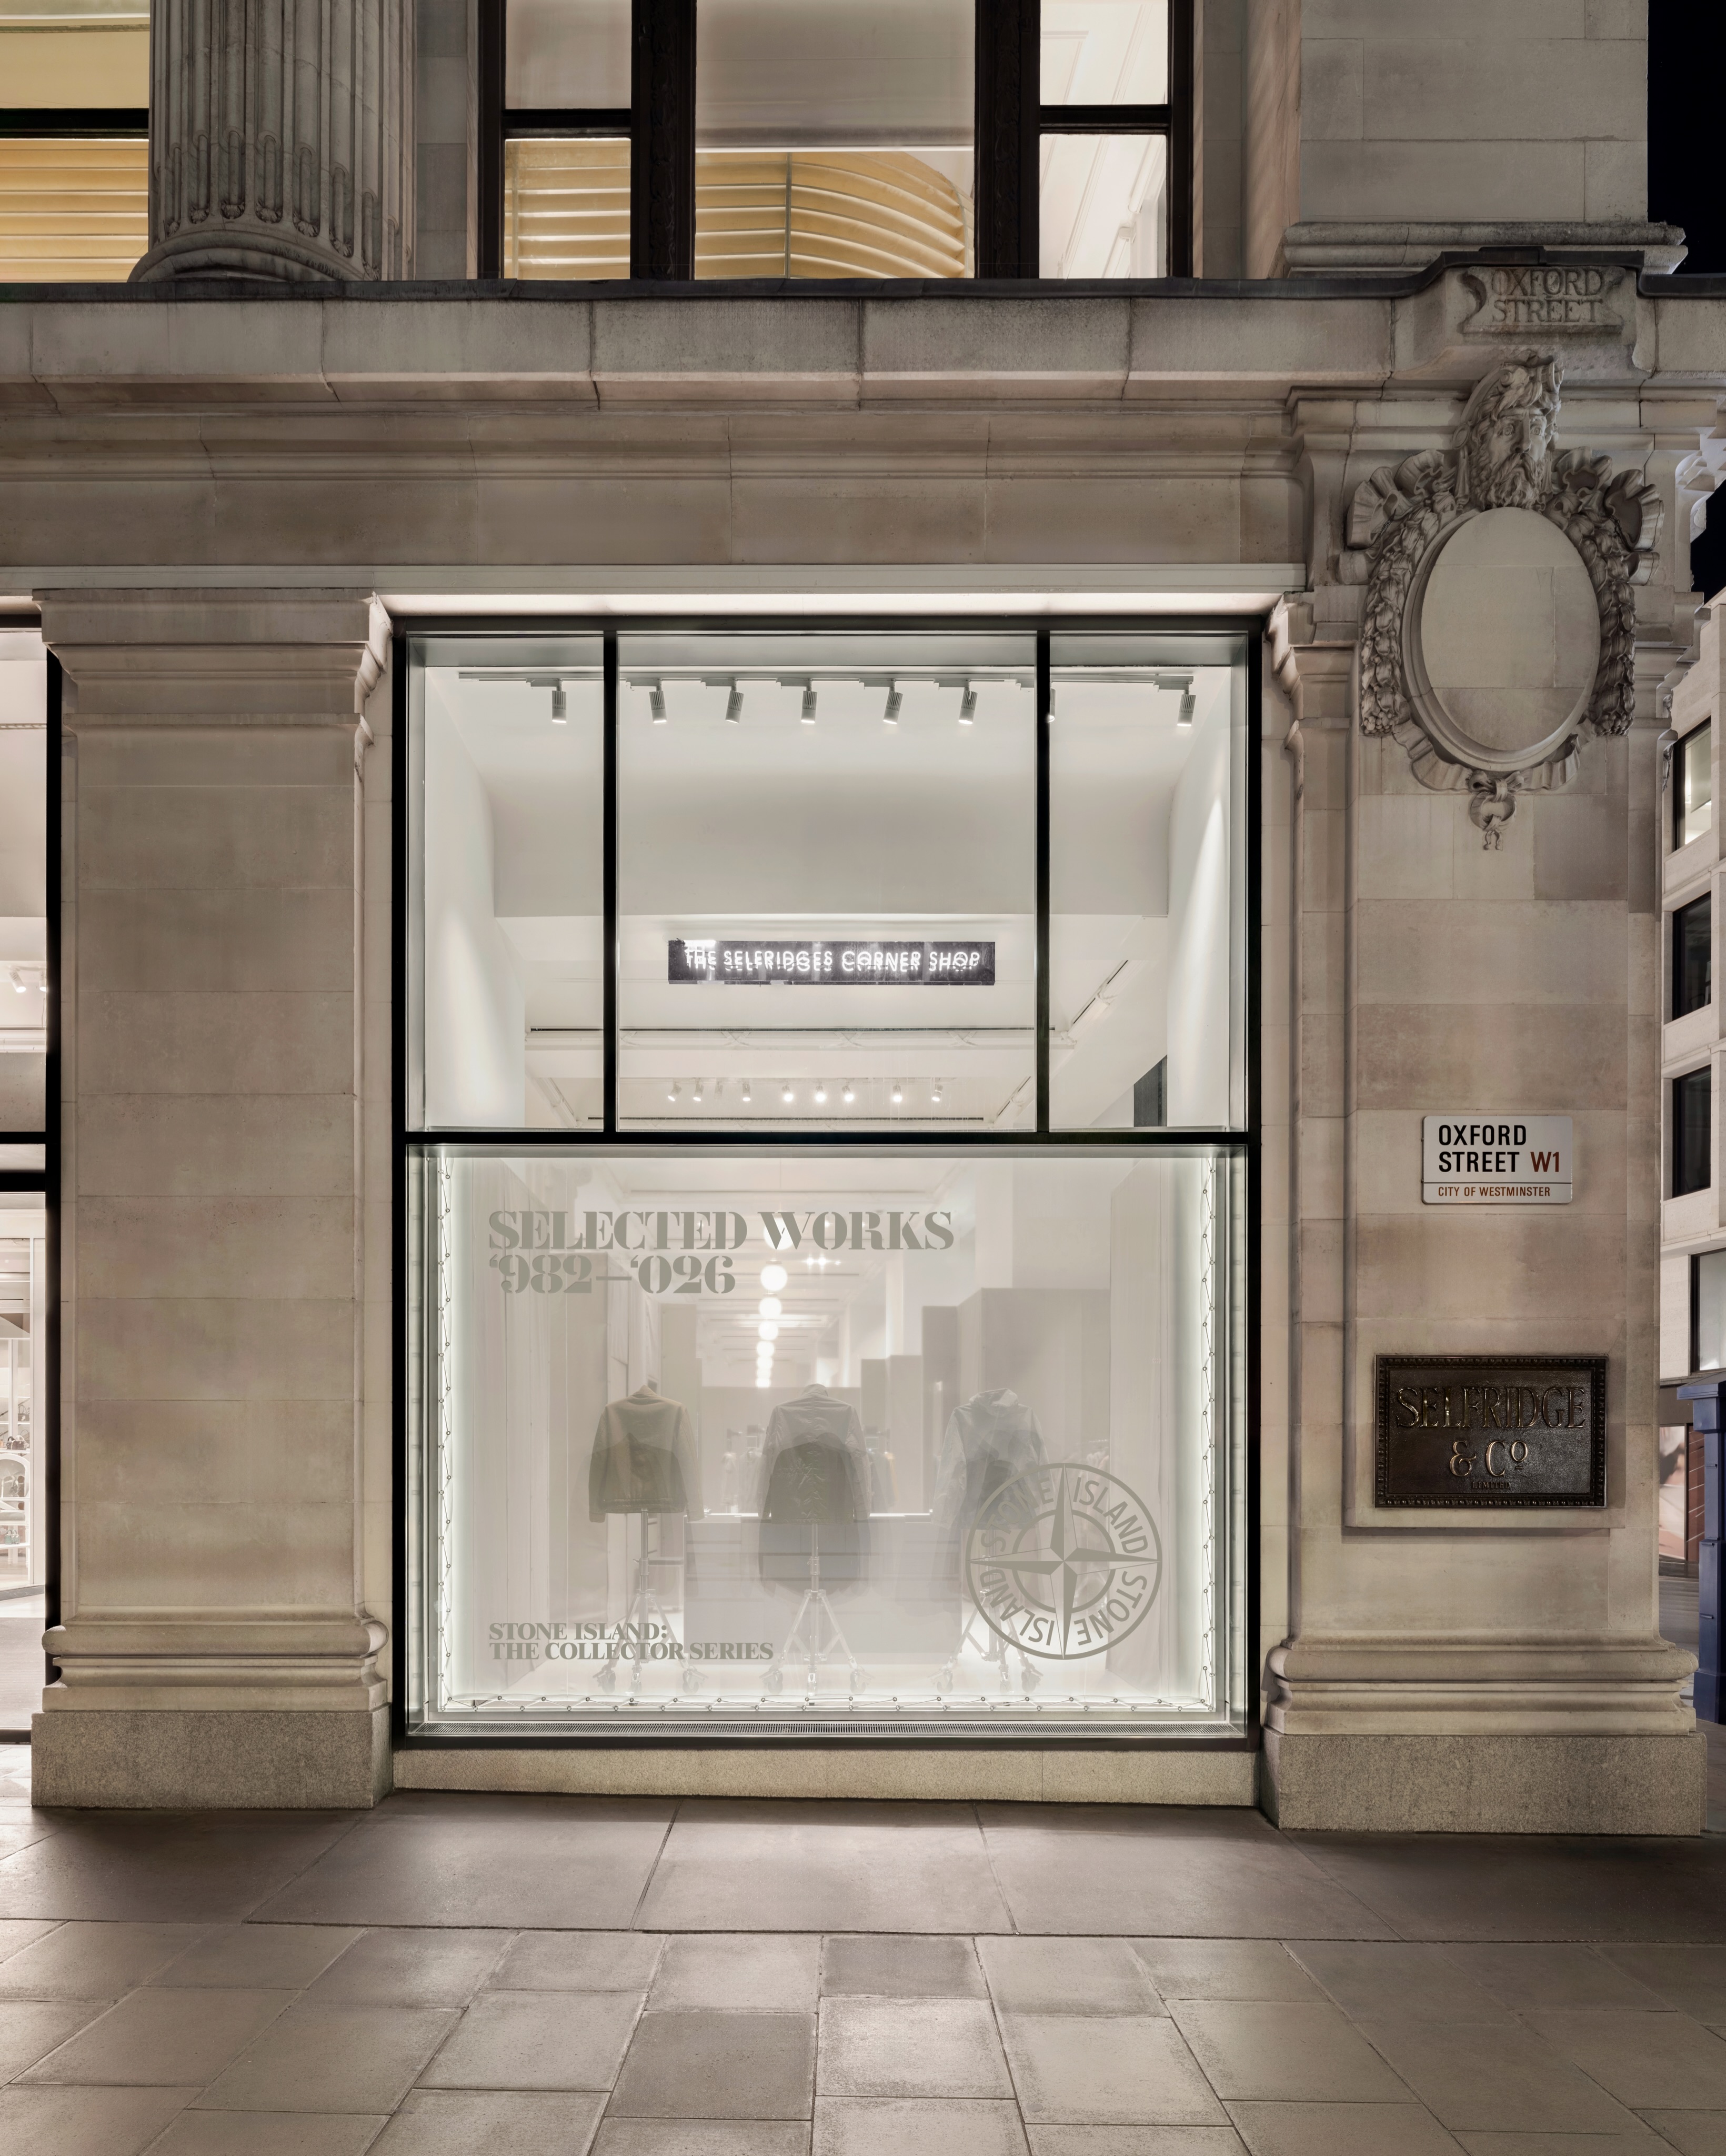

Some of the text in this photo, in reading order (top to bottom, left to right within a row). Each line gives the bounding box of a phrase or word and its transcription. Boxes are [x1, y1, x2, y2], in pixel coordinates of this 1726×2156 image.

[1491, 268, 1603, 296] OXFORD
[1492, 299, 1603, 323] STREET
[685, 950, 980, 972] THE SELFRIDGES CORNER SHOP
[1439, 1125, 1526, 1145] OXFORD
[1439, 1151, 1559, 1172] STREET W1
[1439, 1187, 1550, 1196] CITY OF WESTMINSTER
[489, 1211, 955, 1250] SELECTED WORKS
[1396, 1386, 1585, 1428] SELFRIDGE
[1449, 1440, 1476, 1477] &
[981, 1477, 1148, 1554] STONE ISLAND
[980, 1569, 1147, 1646] STONE ISLAND
[489, 1622, 667, 1640] STONE ISLAND:
[489, 1642, 773, 1660] THE COLLECTOR SERIES
